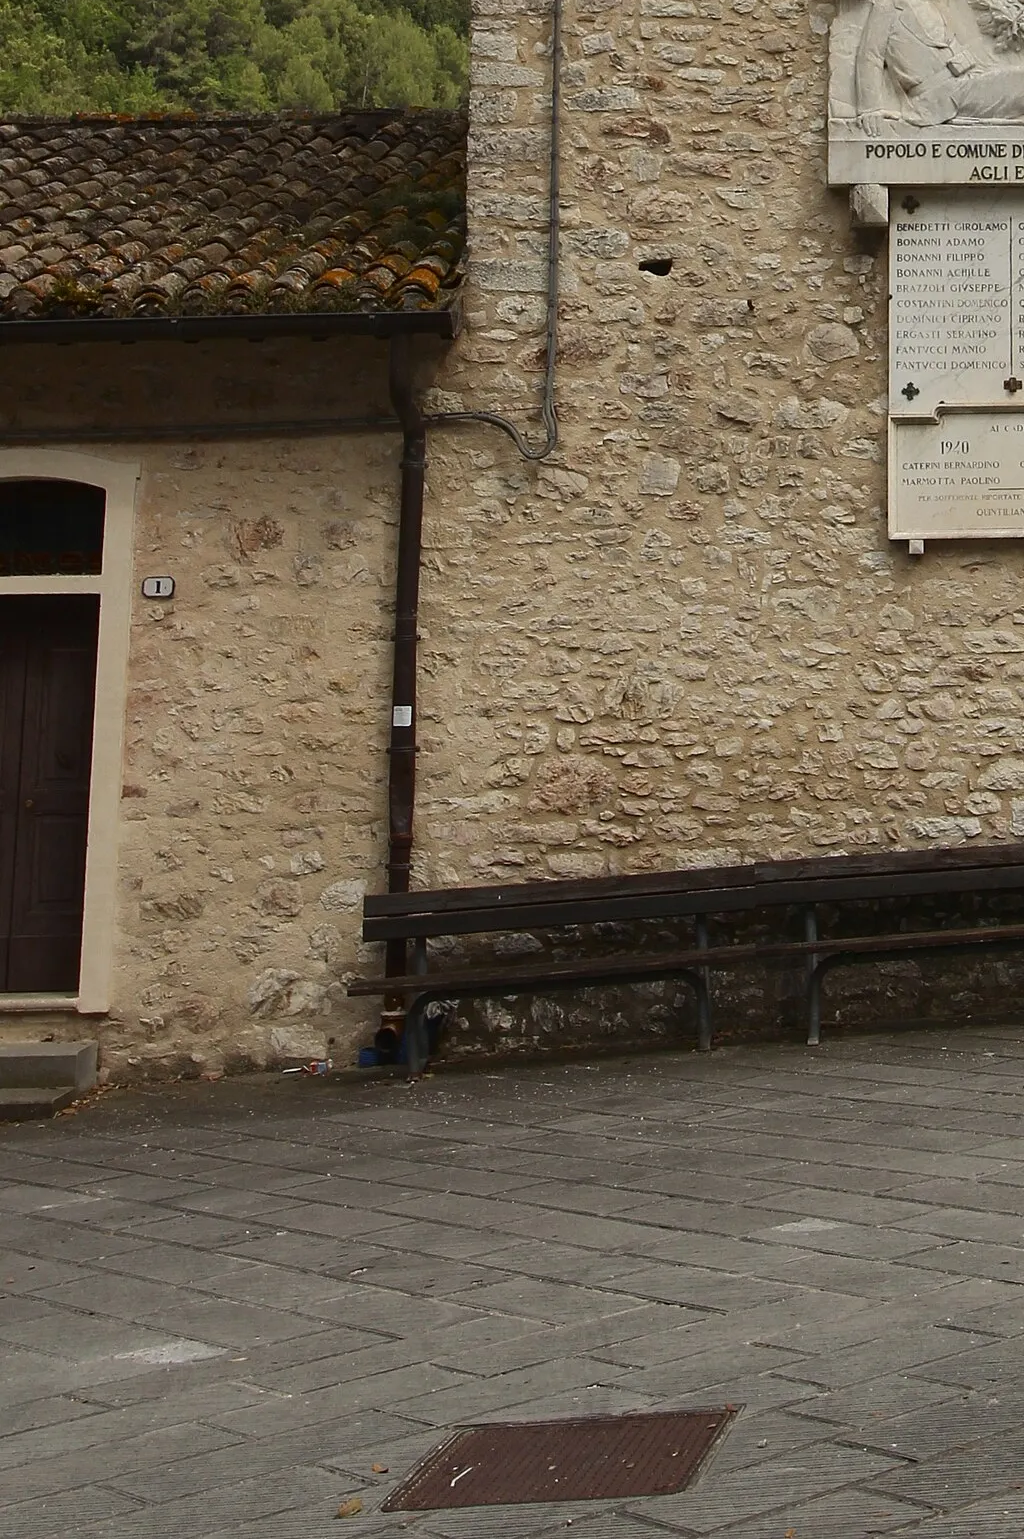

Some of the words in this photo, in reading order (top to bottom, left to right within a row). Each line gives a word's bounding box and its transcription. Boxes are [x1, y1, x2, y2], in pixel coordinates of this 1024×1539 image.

[865, 143, 927, 159] POPOLO
[931, 144, 942, 158] E
[946, 144, 1008, 159] COMUNE
[969, 166, 1008, 181] AGLI
[896, 223, 950, 232] BENEDETTI
[954, 223, 1008, 231] GIROLAMO
[897, 238, 941, 247] BONANNI
[946, 238, 985, 247] ADAMO
[897, 254, 941, 262] BONANNI
[947, 253, 985, 262] FILIPPO
[897, 269, 943, 278] BONANNI
[948, 268, 990, 277] ACHILLE
[897, 300, 954, 308] COSTANTINI
[957, 299, 1008, 308] DOMENICO
[951, 314, 1002, 323] CIPRIANO
[946, 330, 997, 339] SERAFINO
[951, 361, 1007, 370] DOMENICO
[941, 441, 969, 455] 1940
[902, 462, 940, 470] CATERINI
[944, 461, 1000, 470] BERNARDINO
[902, 478, 955, 486] MARMOTTA
[961, 477, 1001, 485] PAOLINO
[155, 581, 161, 594] 1
